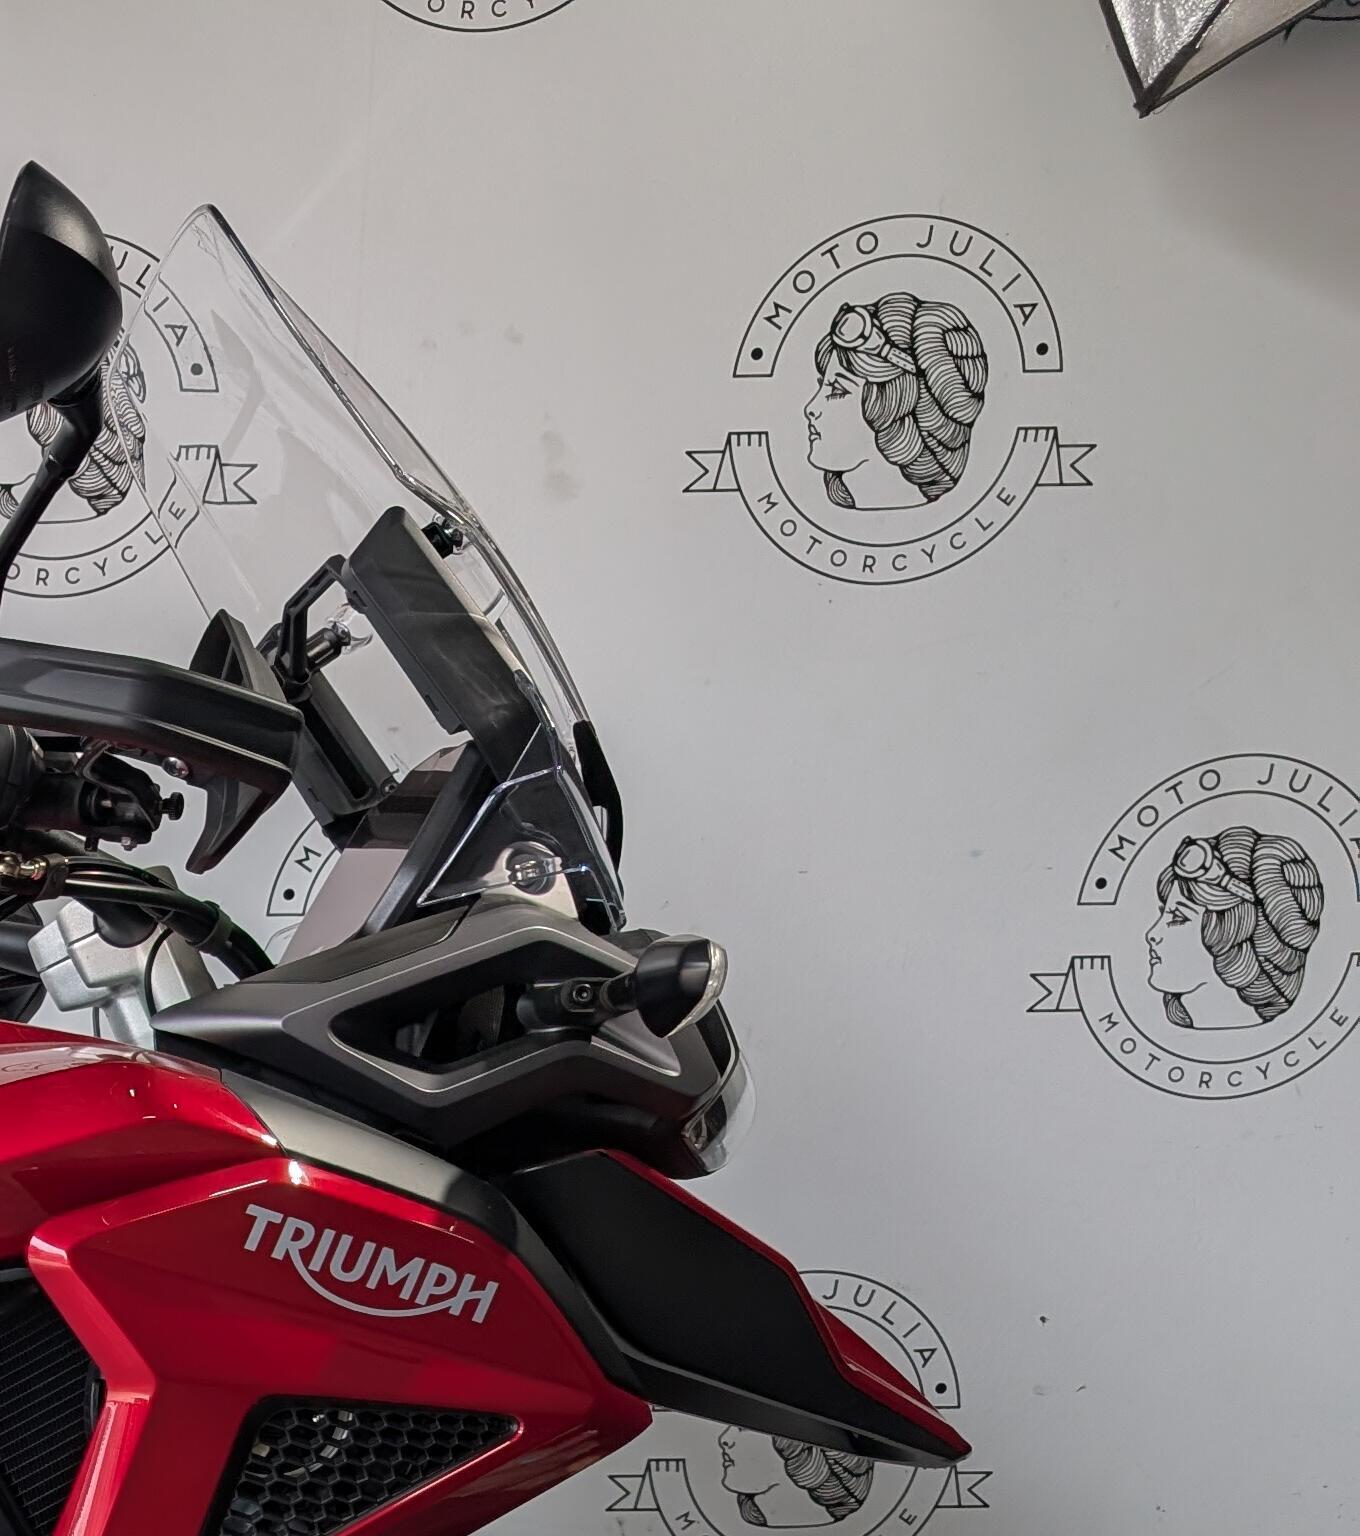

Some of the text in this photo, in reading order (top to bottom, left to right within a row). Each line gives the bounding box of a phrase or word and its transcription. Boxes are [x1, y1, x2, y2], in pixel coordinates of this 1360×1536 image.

[109, 245, 189, 347] ULIA
[763, 225, 1038, 330] MOTO JULIA
[757, 486, 1017, 573] MOTORCYCLE
[1107, 769, 1221, 861] MOTO
[1099, 1008, 1349, 1089] MOTORCYCLE
[244, 1203, 499, 1324] TRIUMPH
[822, 1279, 938, 1368] JULIA
